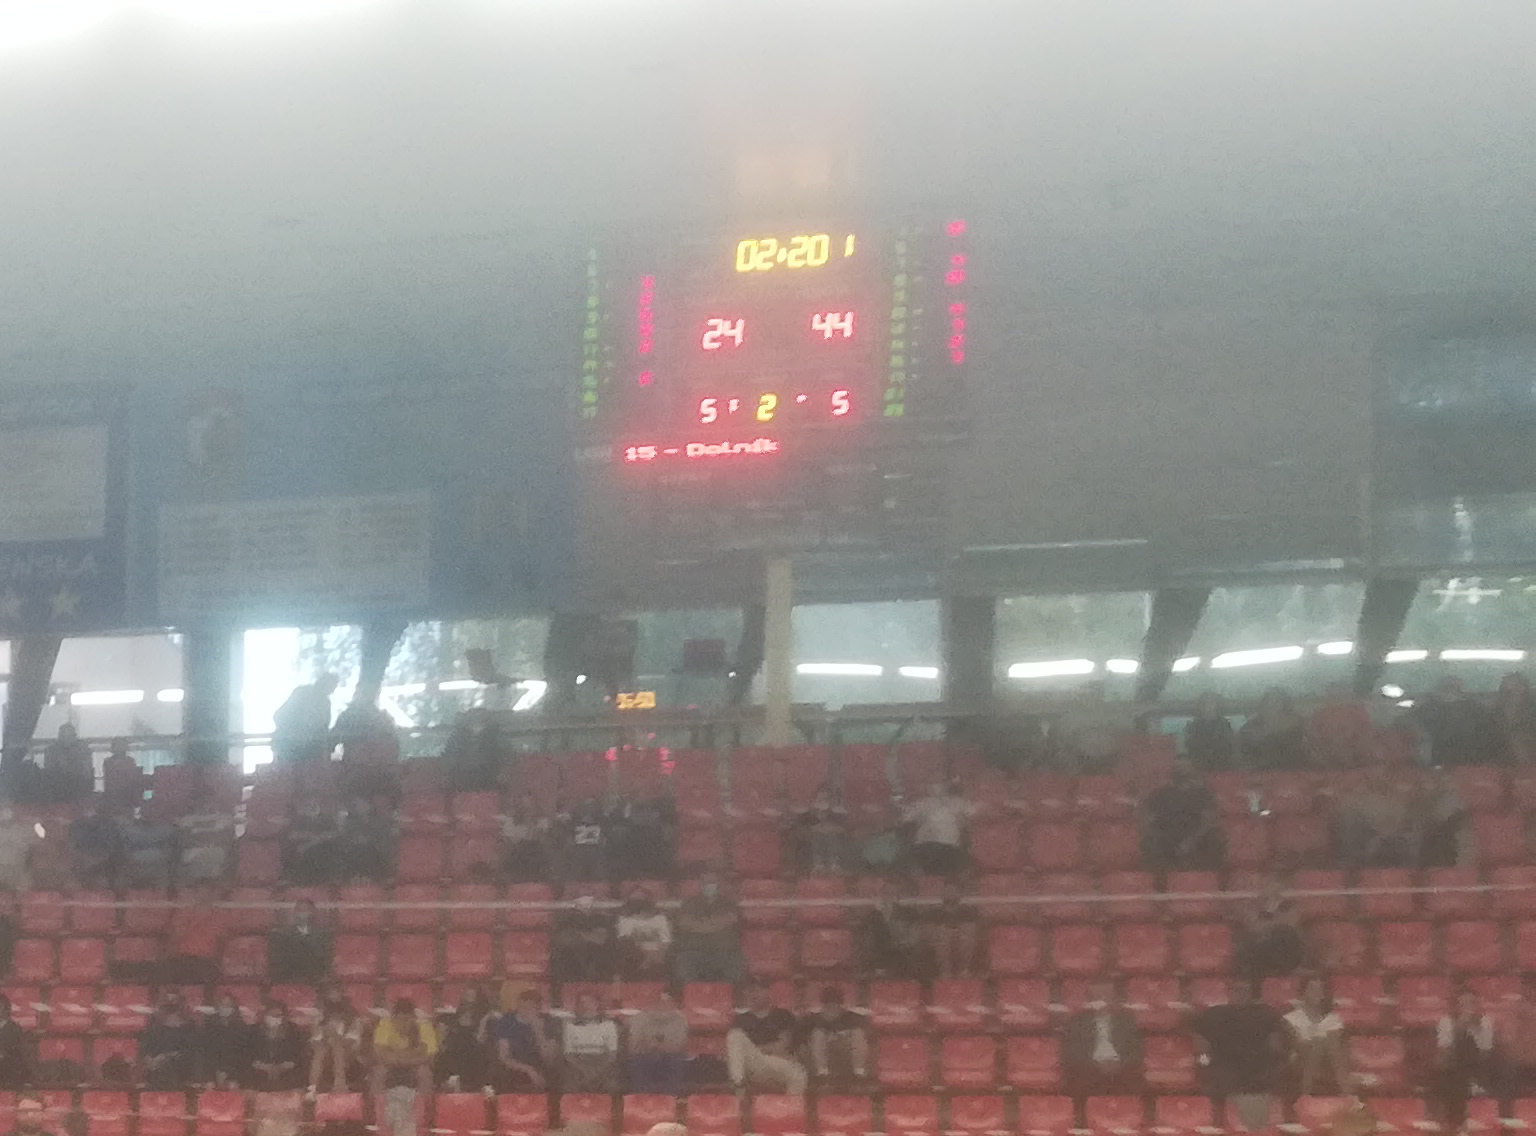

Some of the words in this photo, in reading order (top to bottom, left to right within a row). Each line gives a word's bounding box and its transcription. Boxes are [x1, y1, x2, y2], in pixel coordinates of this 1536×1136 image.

[702, 318, 746, 350] 24
[811, 312, 854, 340] 44
[700, 398, 718, 424] 5
[756, 393, 778, 422] 2
[831, 390, 850, 416] 5
